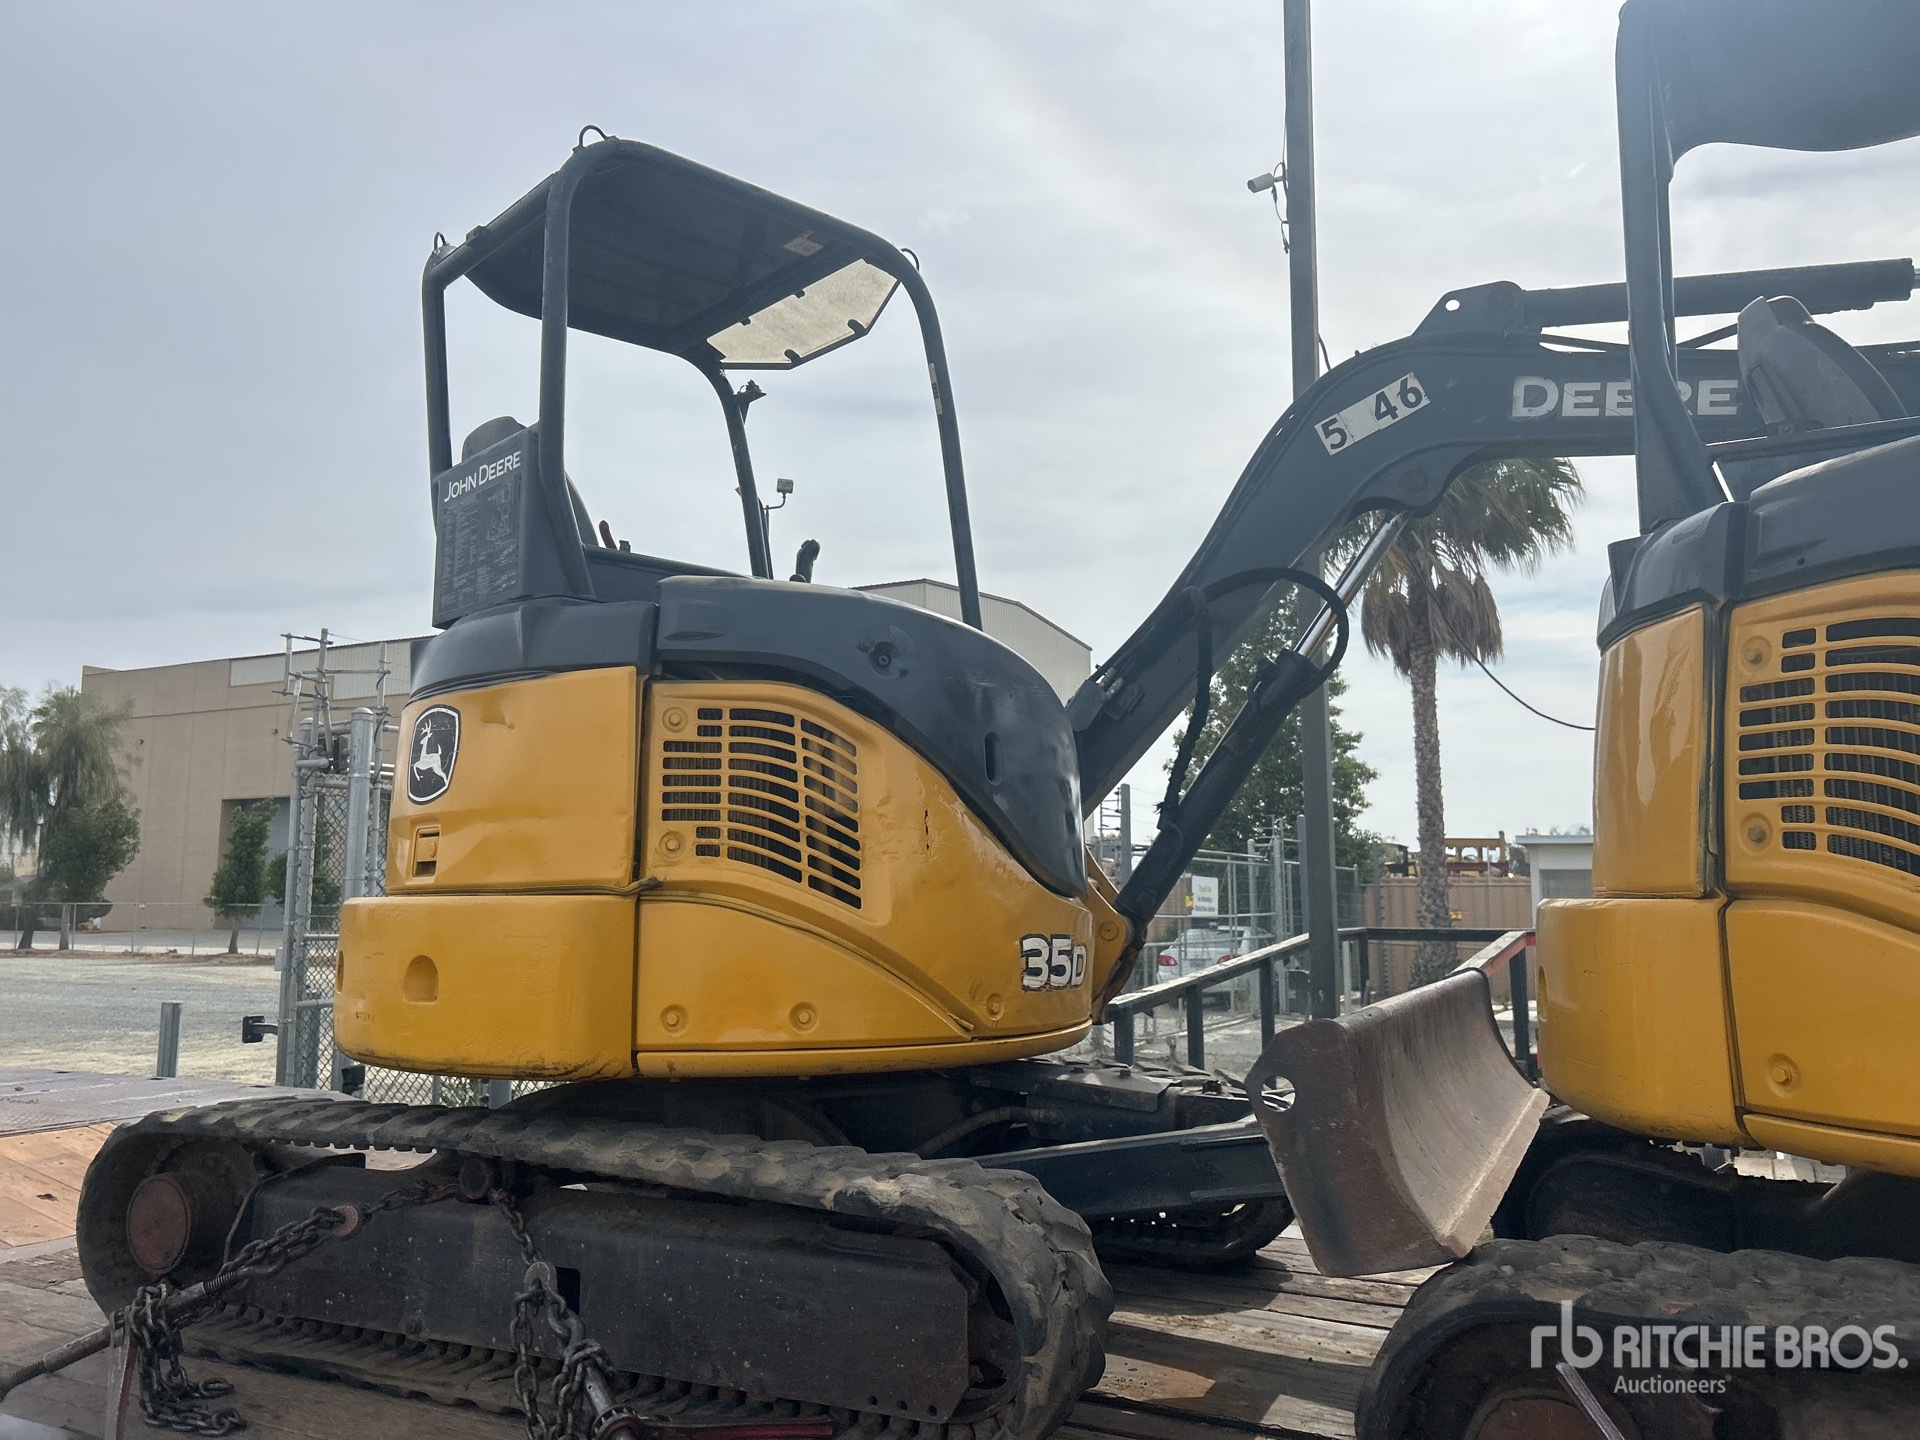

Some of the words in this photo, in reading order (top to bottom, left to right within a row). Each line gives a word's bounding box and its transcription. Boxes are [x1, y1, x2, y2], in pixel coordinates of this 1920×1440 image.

[1321, 417, 1347, 450] 5
[1375, 378, 1423, 421] 46
[1511, 376, 1739, 418] DEEE
[444, 472, 477, 503] JOHN
[478, 451, 522, 486] DEERE
[1020, 934, 1088, 991] 35D
